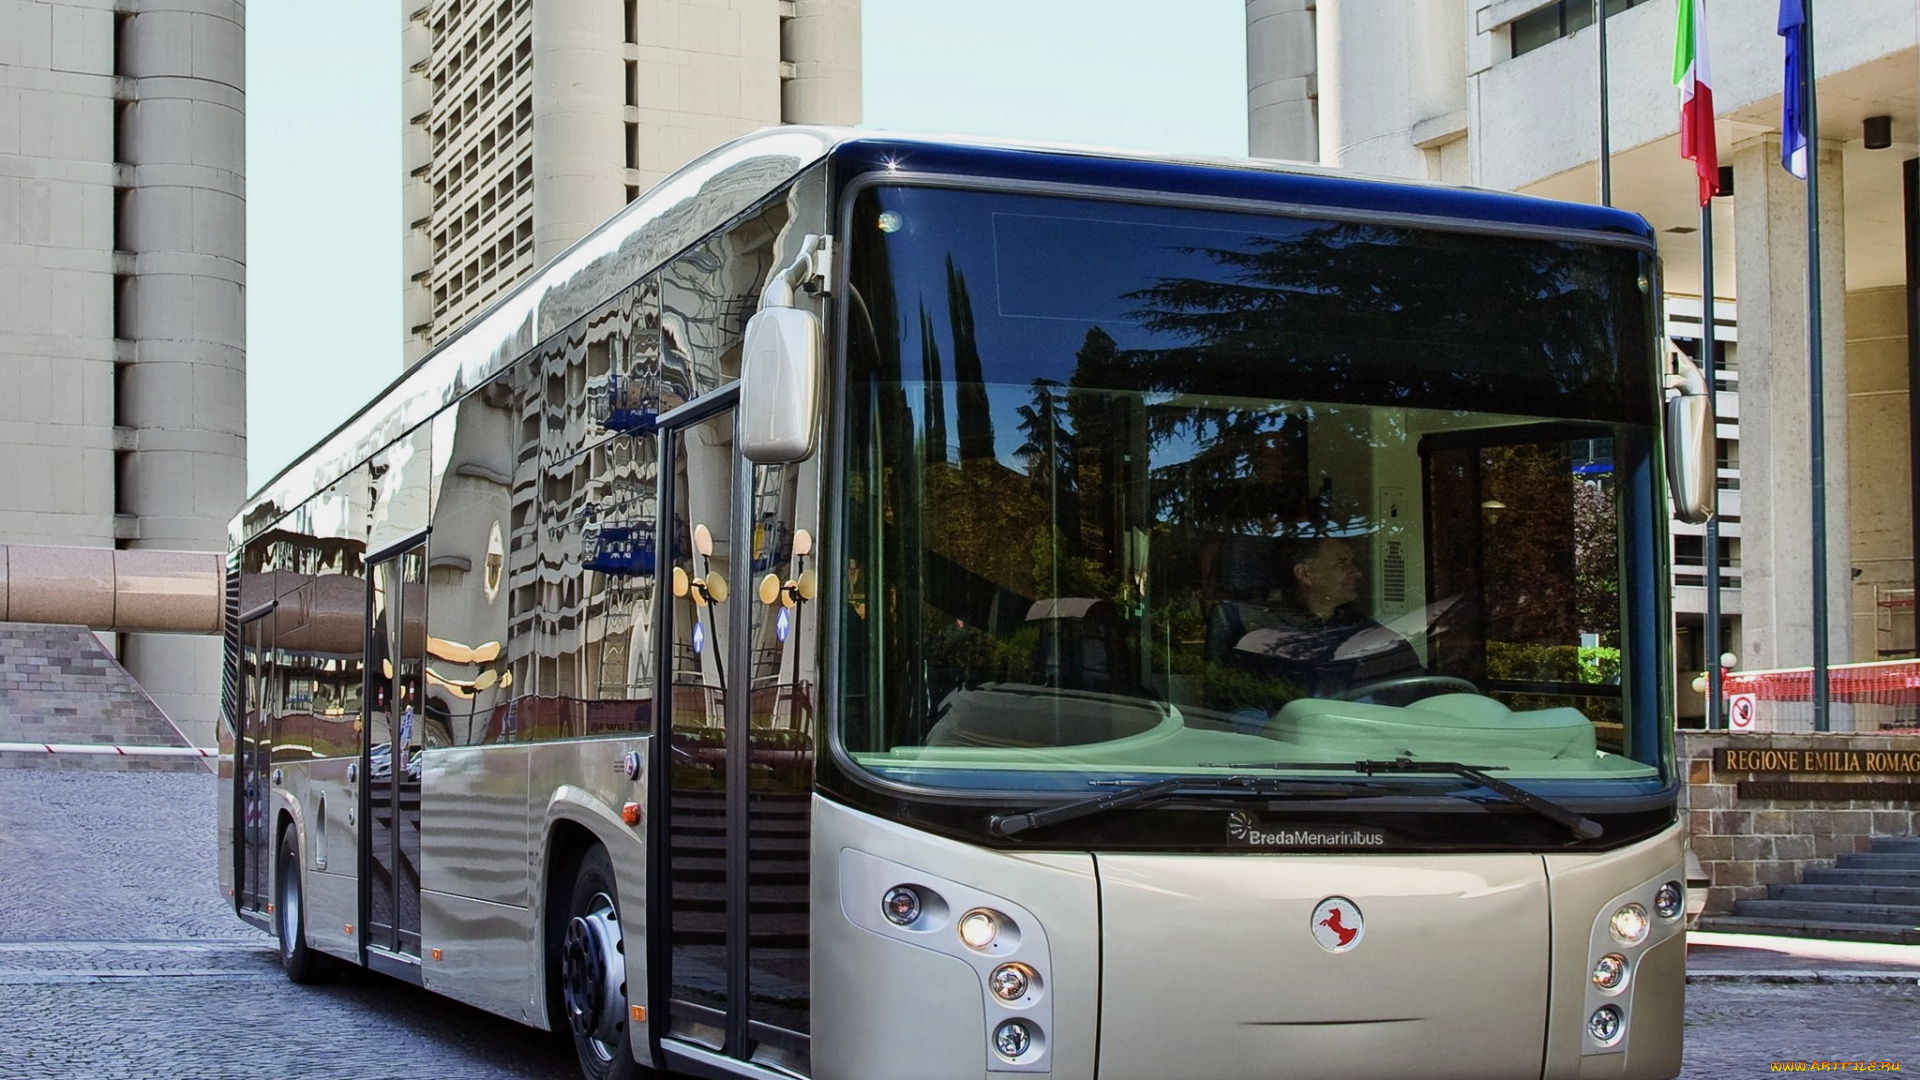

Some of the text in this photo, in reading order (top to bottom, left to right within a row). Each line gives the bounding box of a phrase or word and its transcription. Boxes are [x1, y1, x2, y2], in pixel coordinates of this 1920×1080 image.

[1726, 750, 1799, 771] REGIONE
[1804, 751, 1861, 772] EMILIA
[1249, 830, 1384, 846] BredaMenarinibus
